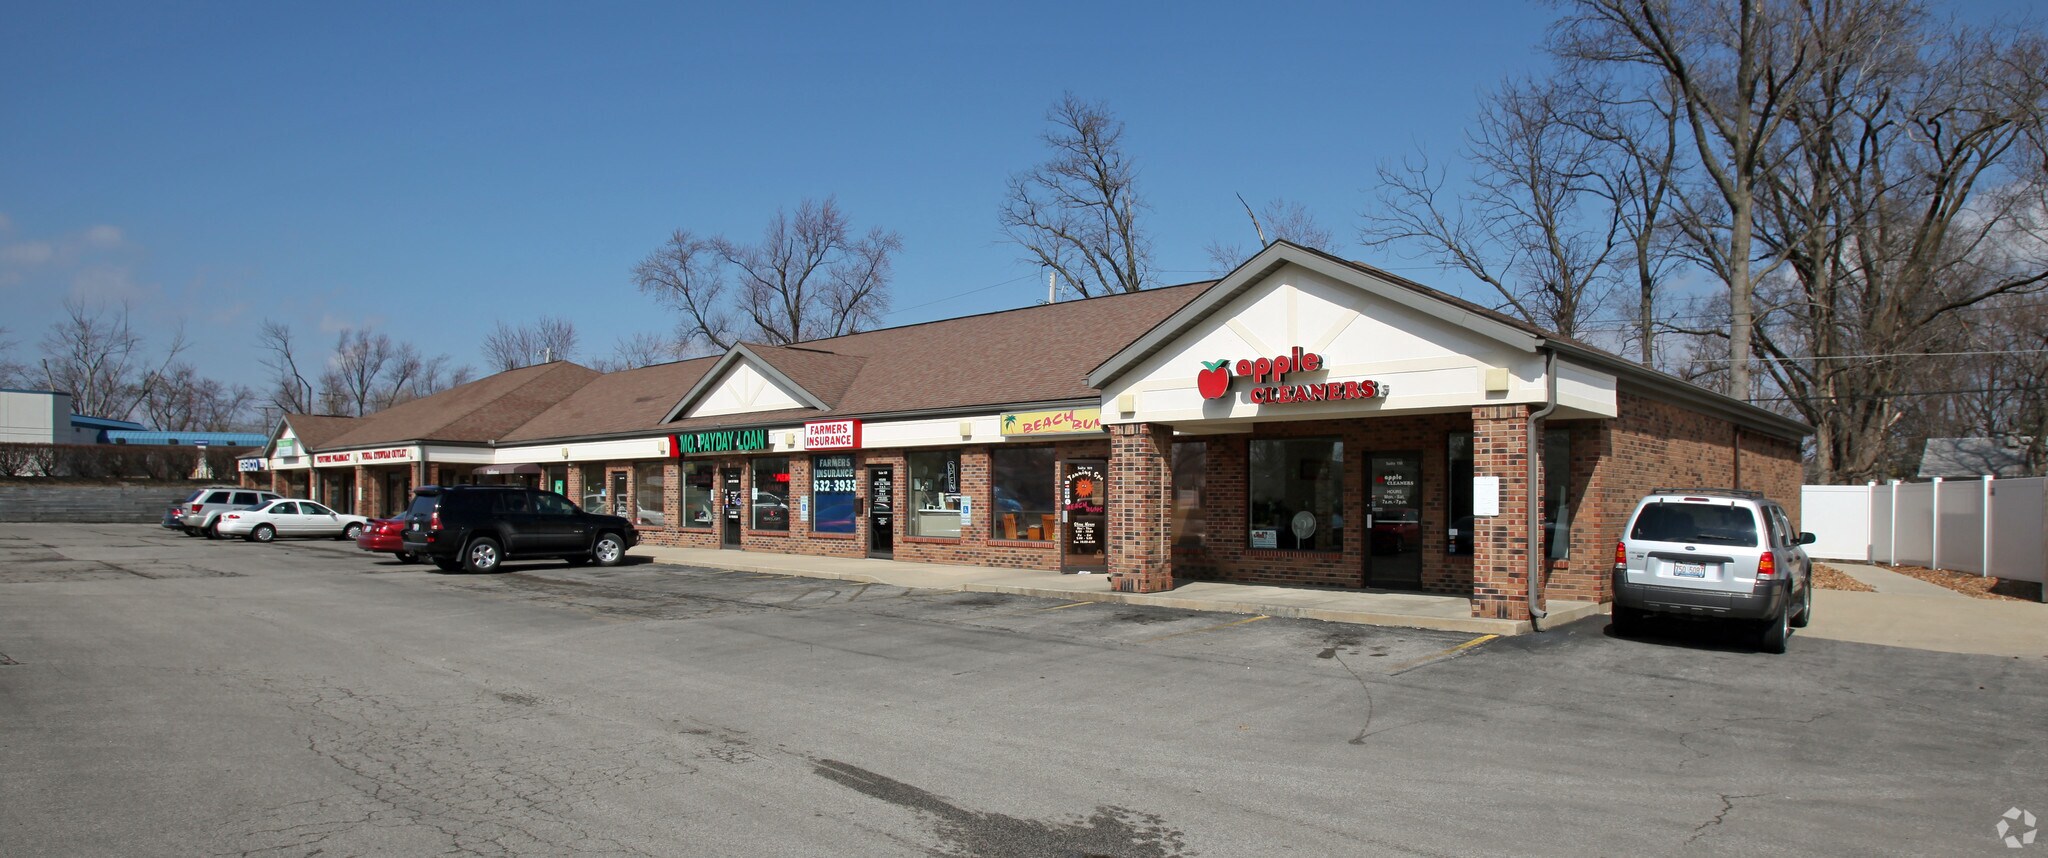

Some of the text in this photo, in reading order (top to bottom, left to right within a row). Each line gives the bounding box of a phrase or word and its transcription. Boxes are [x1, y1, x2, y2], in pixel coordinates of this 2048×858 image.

[1236, 346, 1321, 383] apple
[1250, 380, 1377, 405] CLEANERS
[1023, 410, 1074, 434] BEACH
[810, 424, 848, 435] FARMERS
[680, 429, 764, 454] MO. PAYDAY LOAN
[806, 435, 852, 447] INSURANCE
[240, 459, 258, 471] GEICO
[819, 458, 850, 468] FARMERS
[816, 469, 854, 478] INSURANCE
[1067, 470, 1103, 481] Tanning Spa
[813, 480, 856, 492] 632-3933
